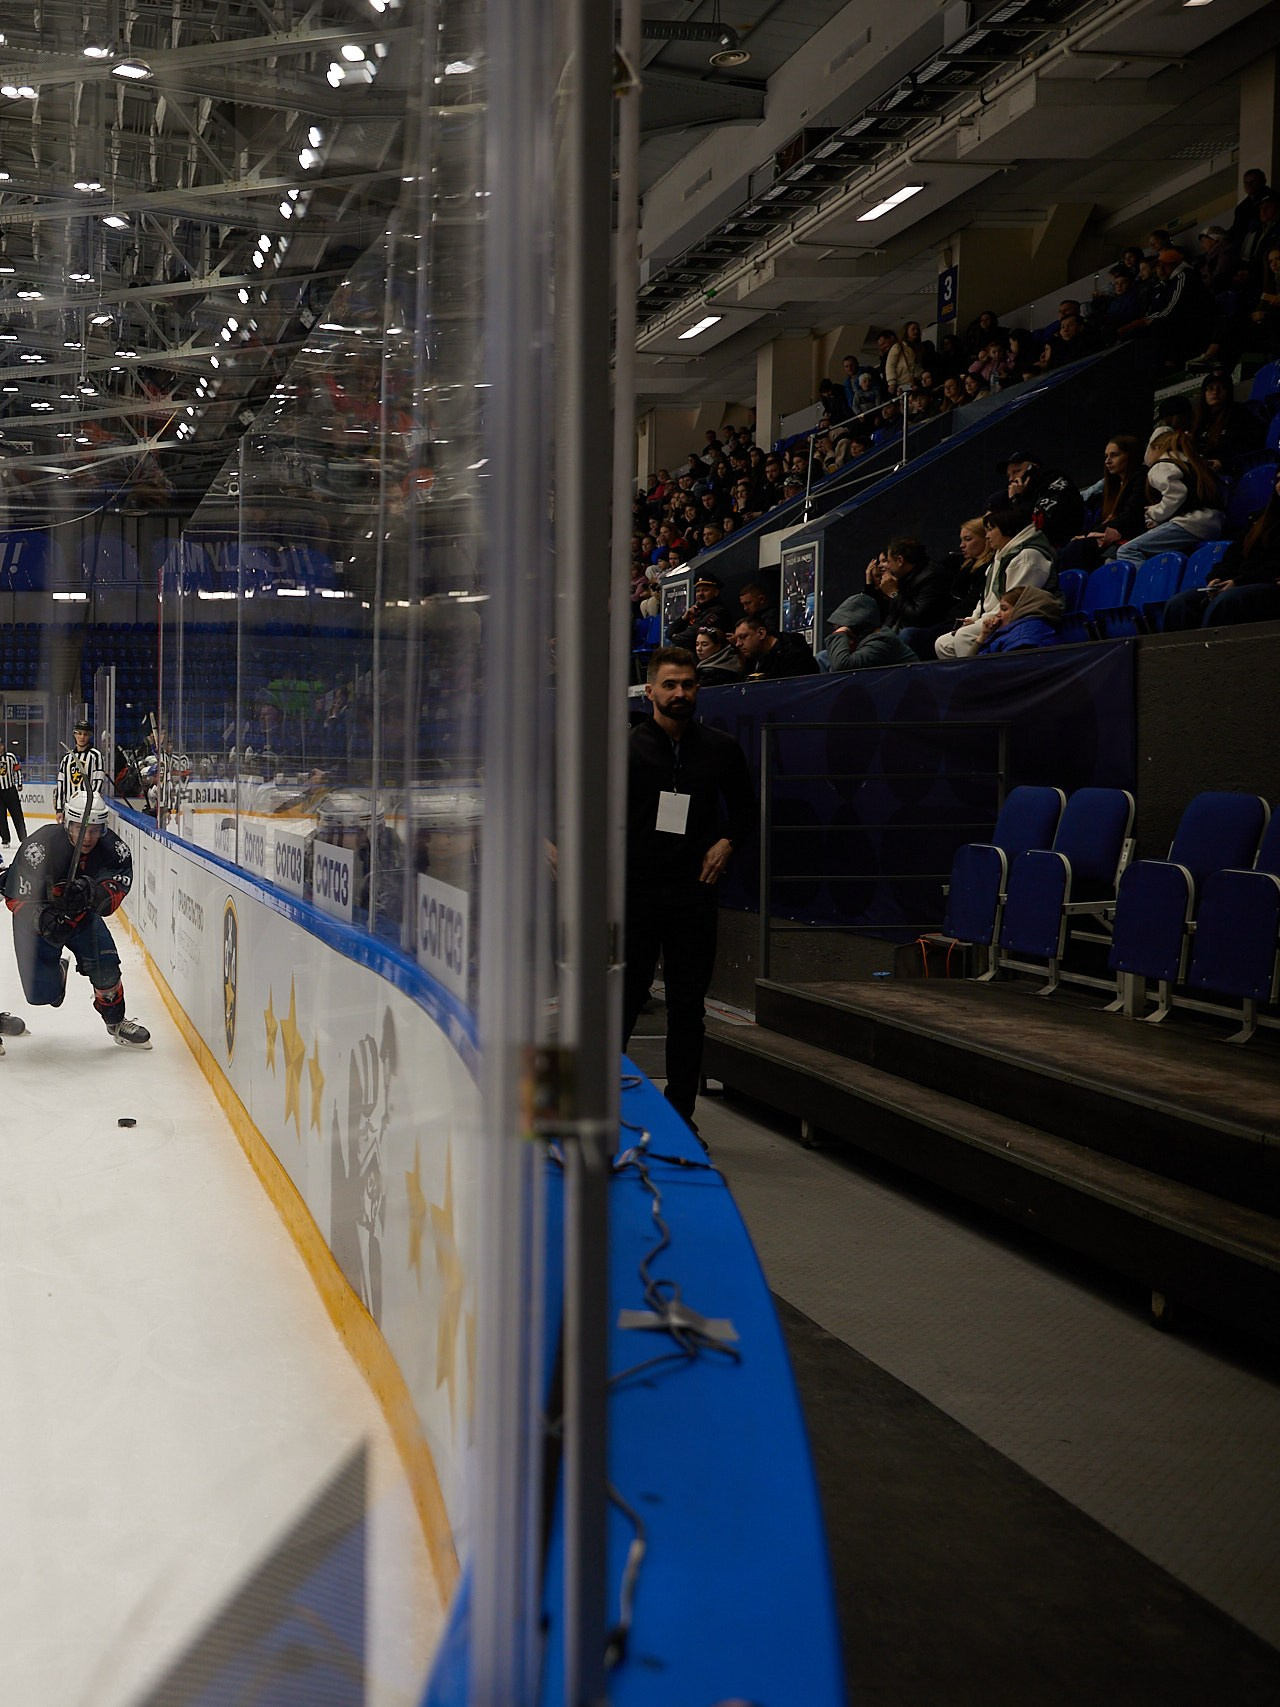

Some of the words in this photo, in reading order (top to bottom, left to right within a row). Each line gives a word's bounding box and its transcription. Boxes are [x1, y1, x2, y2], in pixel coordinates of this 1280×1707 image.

[944, 275, 953, 301] 3
[275, 841, 302, 884] согаз
[316, 854, 349, 906] согаз
